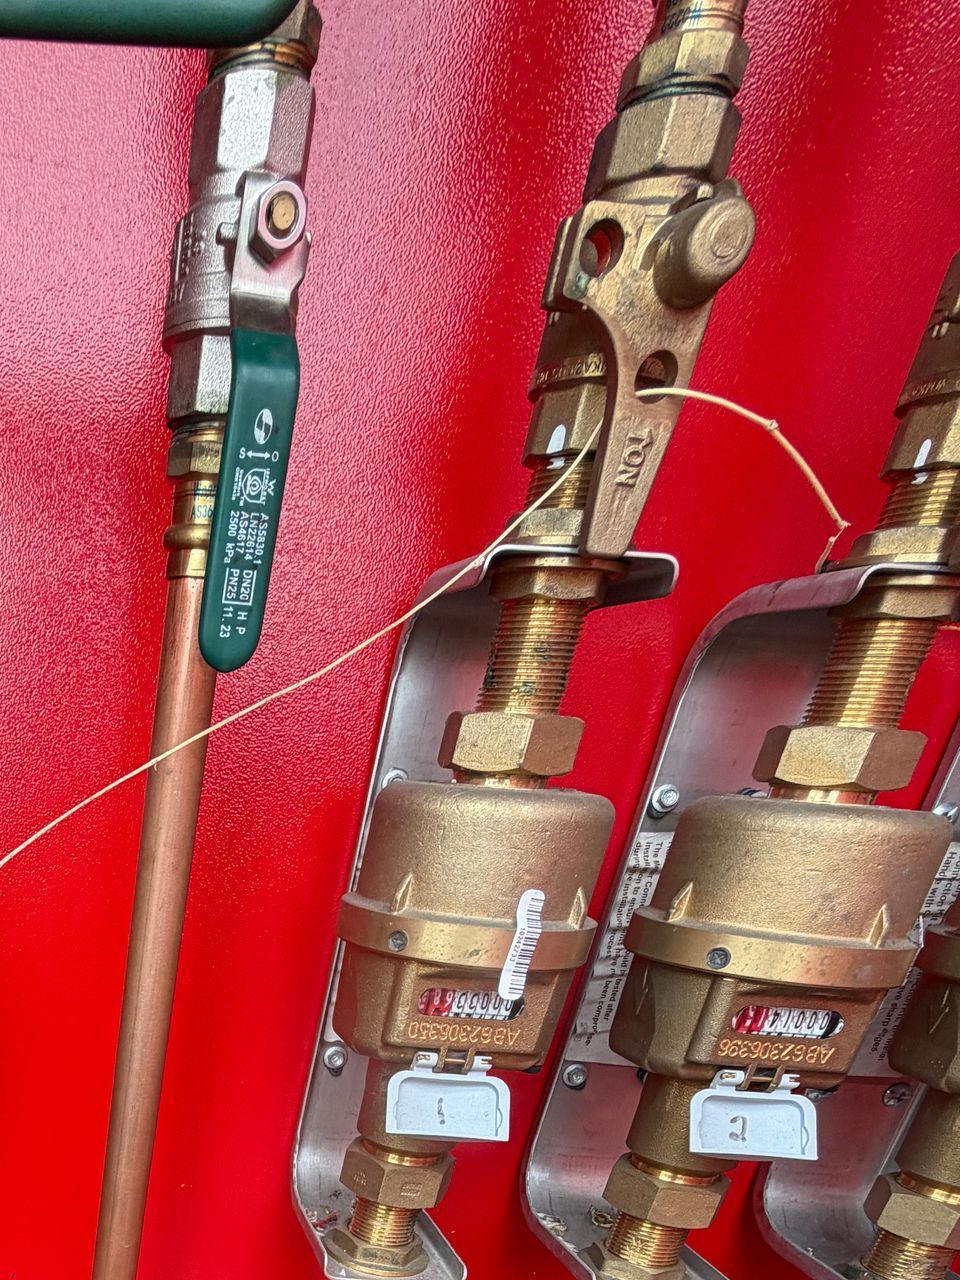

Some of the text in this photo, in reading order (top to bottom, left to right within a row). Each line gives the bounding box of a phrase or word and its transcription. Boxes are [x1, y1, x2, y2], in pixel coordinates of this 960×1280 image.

[223, 510, 239, 564] 2500 kPa
[235, 510, 250, 554] AS4617
[244, 512, 260, 561] LN22614
[253, 512, 269, 565] AS5830.1
[226, 568, 240, 600] PN25
[239, 569, 253, 601] DN20
